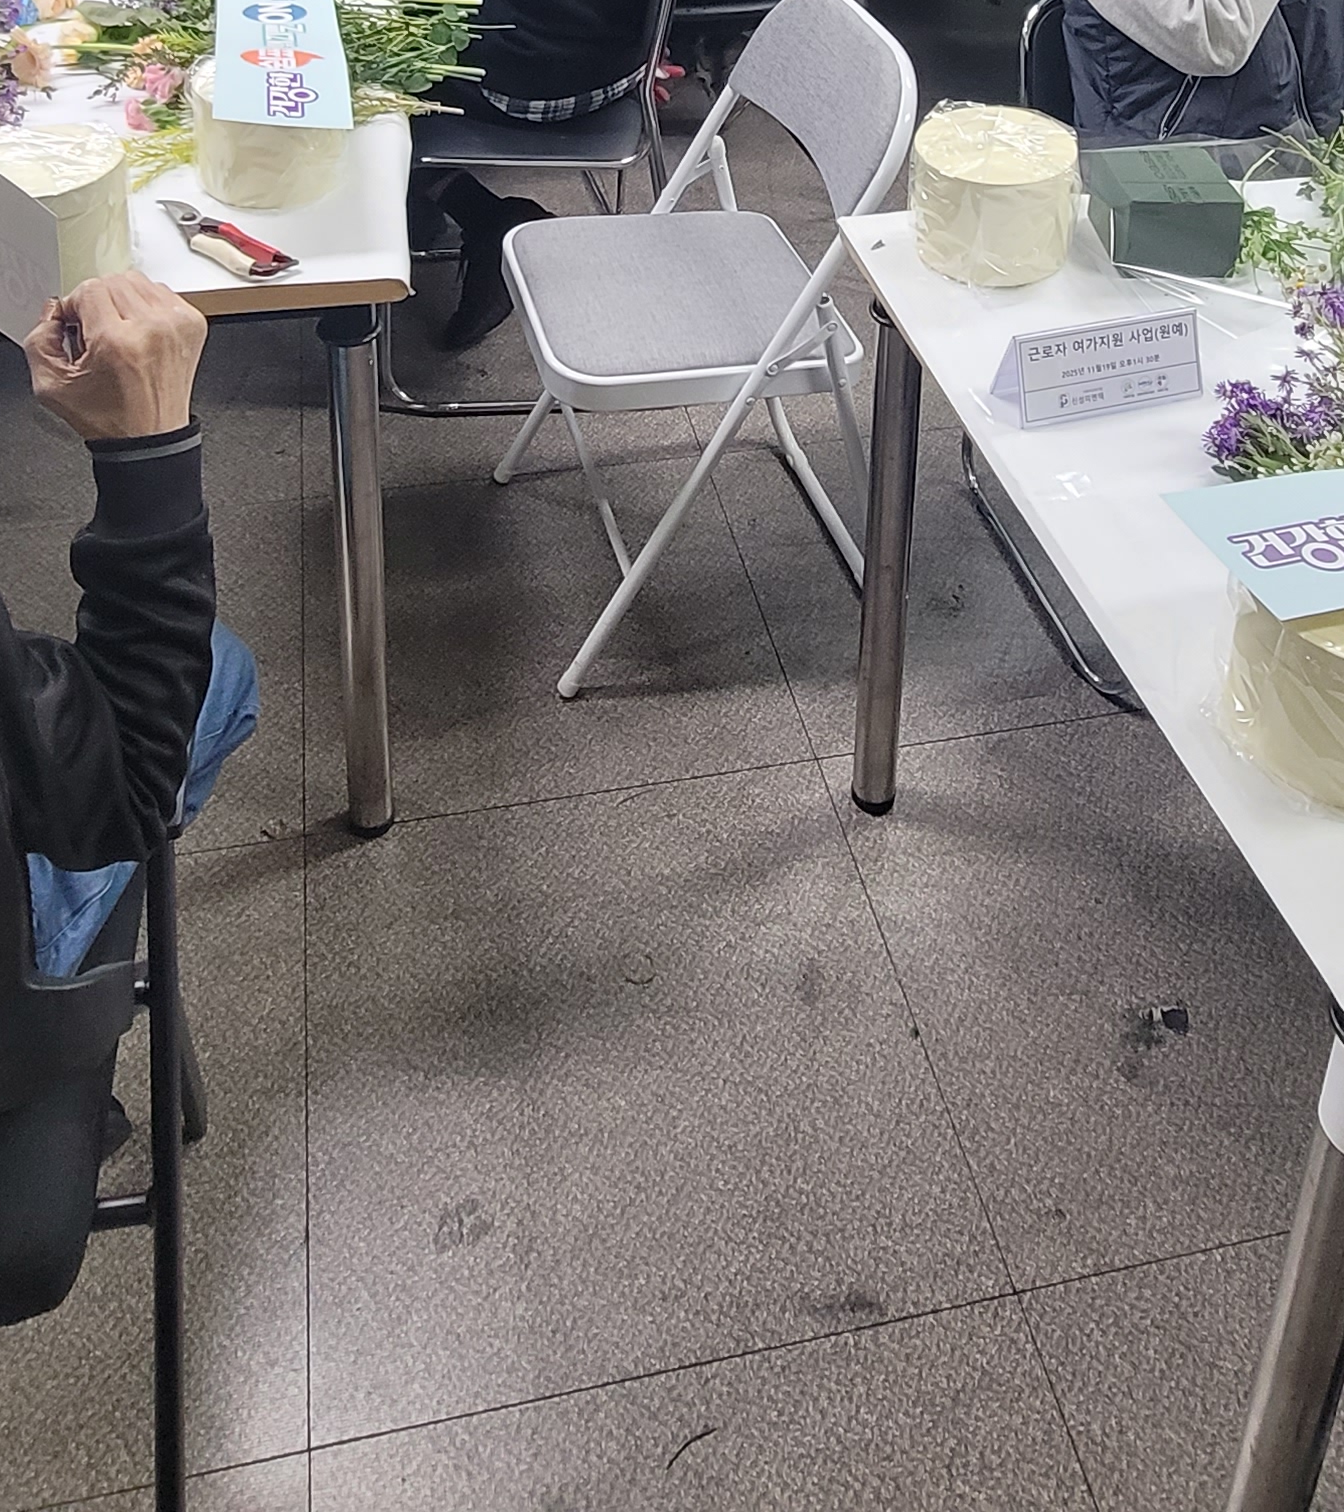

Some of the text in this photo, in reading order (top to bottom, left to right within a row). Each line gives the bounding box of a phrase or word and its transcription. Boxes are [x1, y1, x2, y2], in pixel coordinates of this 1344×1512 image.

[267, 71, 319, 119] 건강한
[1027, 321, 1189, 362] 근로자 여가지원 사업(원예)
[1062, 367, 1085, 378] 2025년
